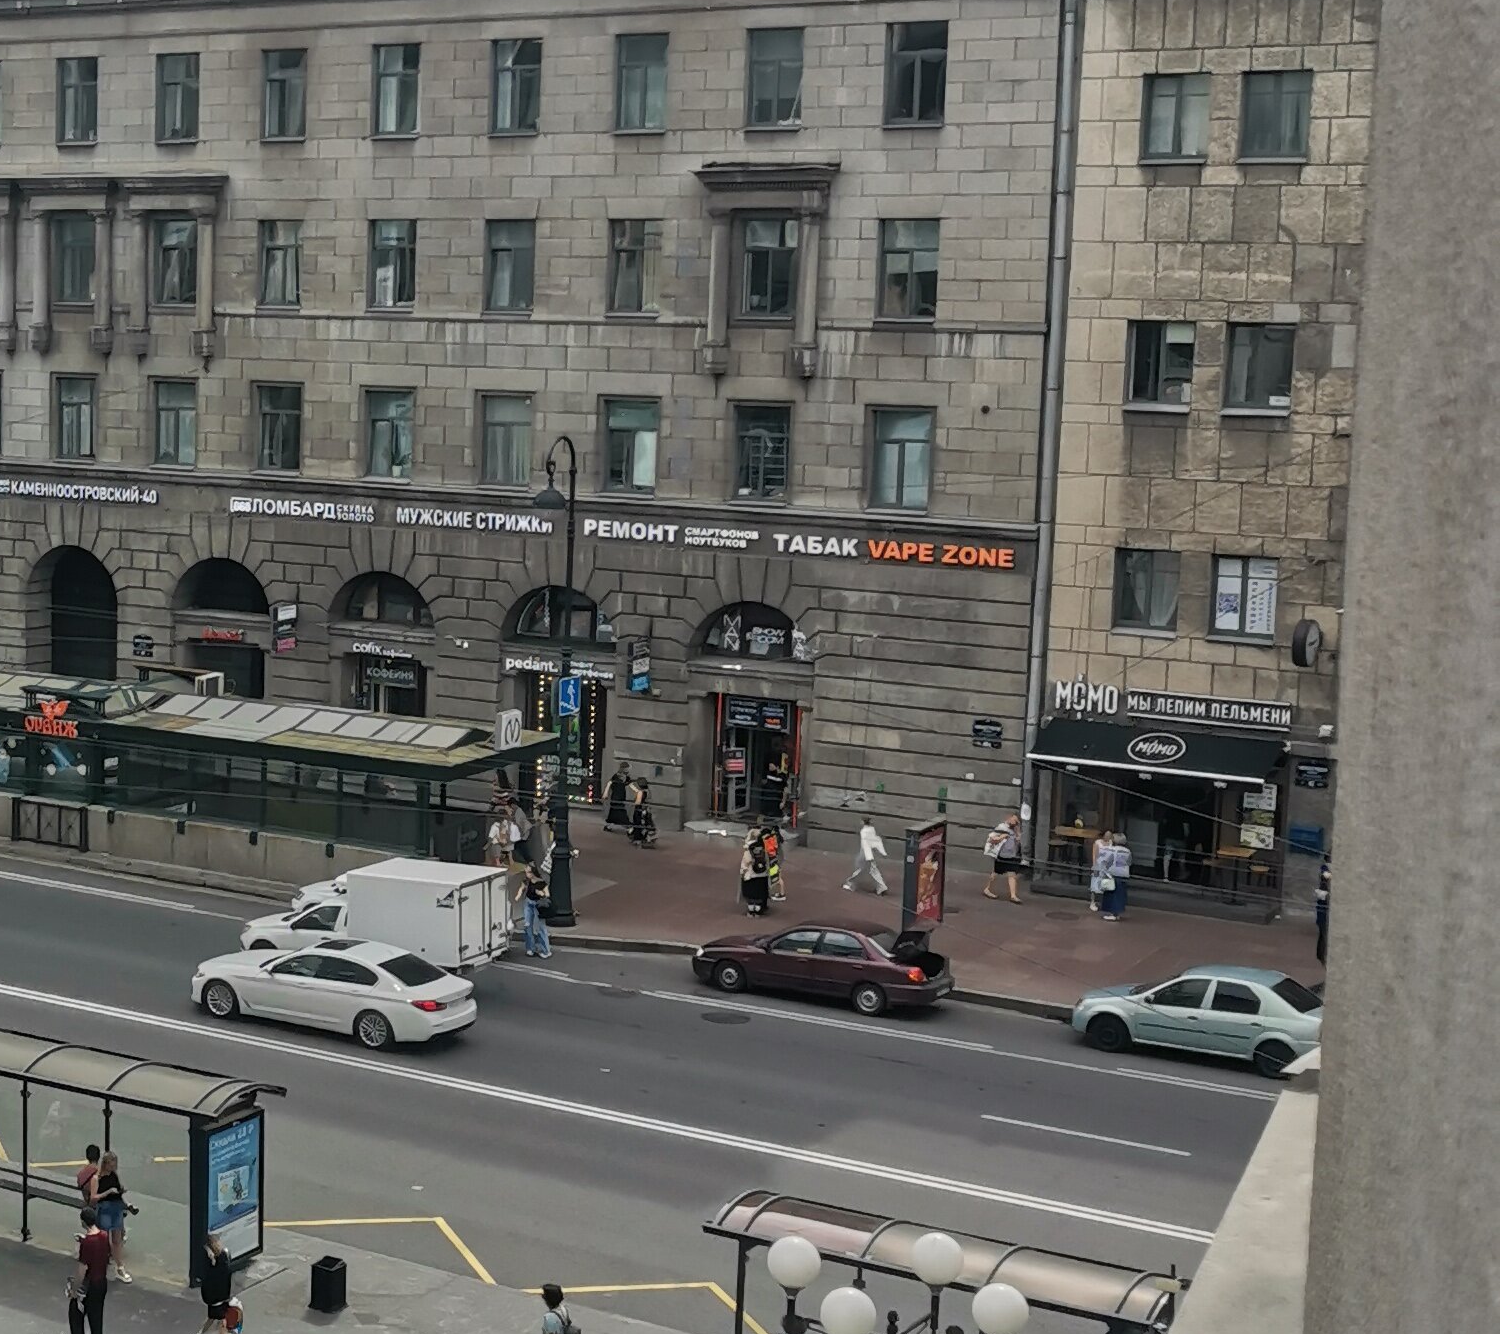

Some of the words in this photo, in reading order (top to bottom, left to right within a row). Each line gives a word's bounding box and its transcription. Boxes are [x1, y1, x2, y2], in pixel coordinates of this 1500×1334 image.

[252, 498, 336, 520] ЛОМБАРД
[396, 506, 472, 529] МУЖСКИЕ
[583, 518, 680, 543] РЕМОНТ
[773, 533, 859, 557] ТАБАК
[868, 539, 935, 563] VAPE
[941, 544, 1015, 568] ZONE
[1127, 694, 1151, 712] МЫ
[1156, 696, 1207, 717] ЛЕПИМ
[1210, 702, 1292, 726] ПЕЛЬМЕНИ
